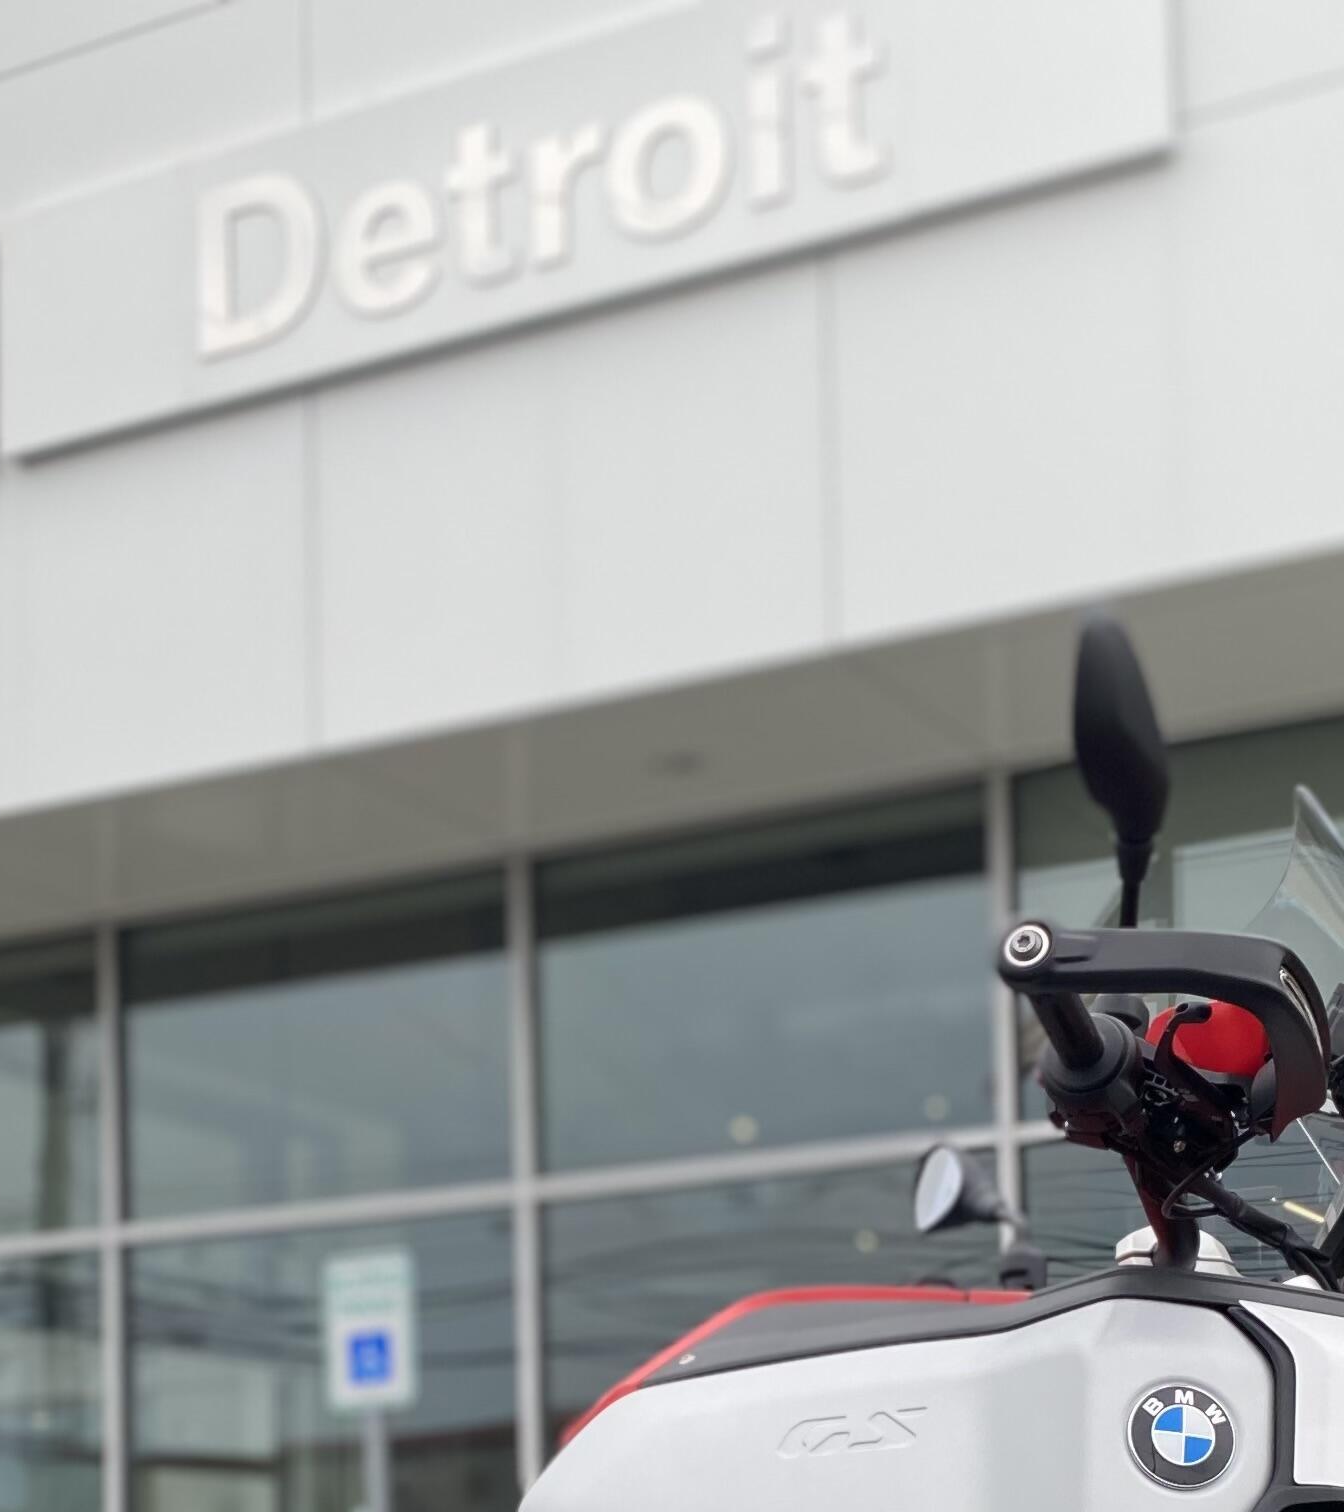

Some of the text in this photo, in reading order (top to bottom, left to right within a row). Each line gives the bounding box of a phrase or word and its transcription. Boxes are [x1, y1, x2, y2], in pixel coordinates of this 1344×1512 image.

[197, 12, 885, 363] Detroit
[775, 1405, 929, 1459] GS
[1142, 1388, 1227, 1427] BMW
